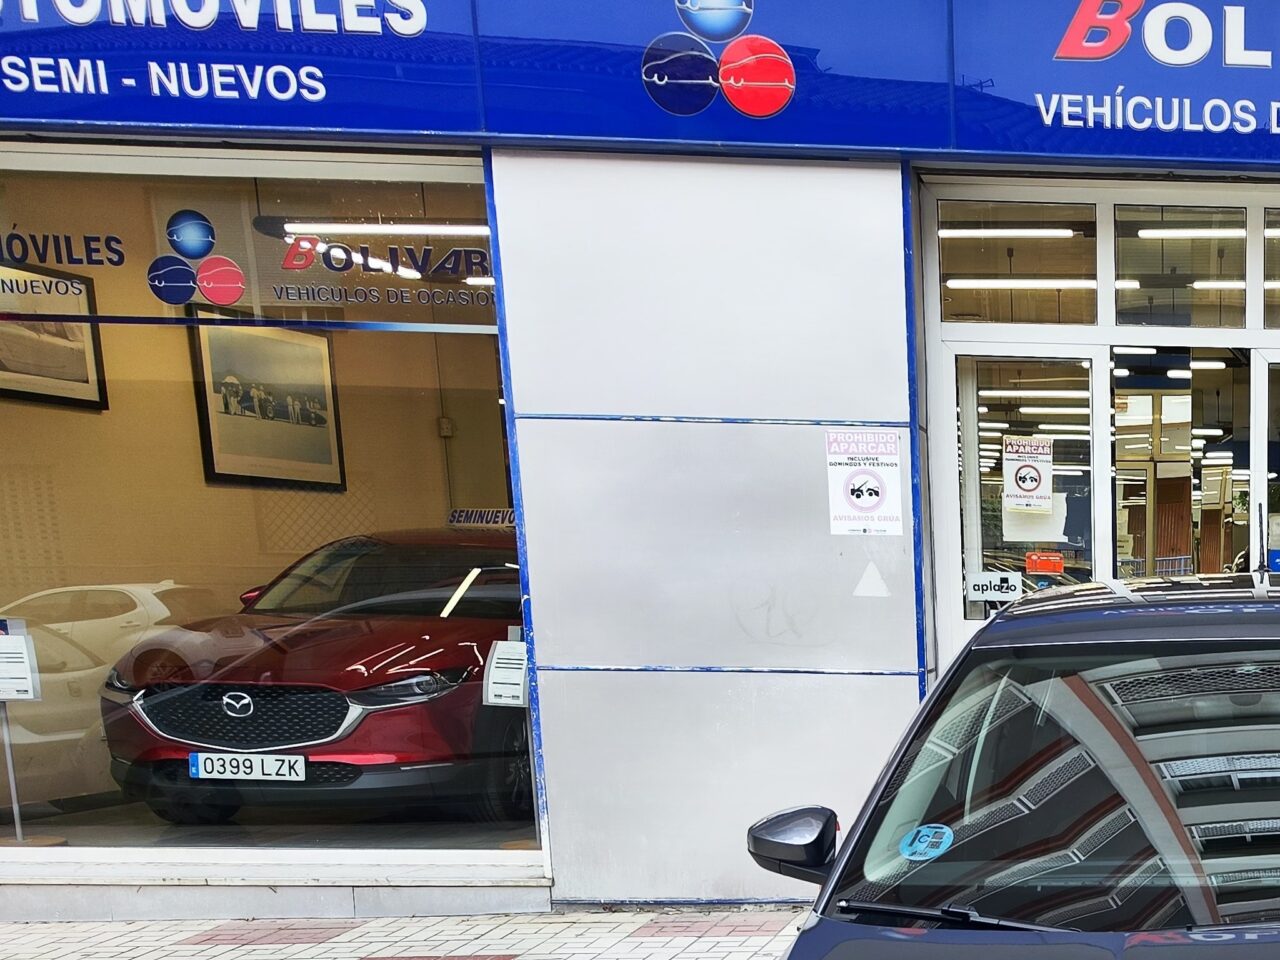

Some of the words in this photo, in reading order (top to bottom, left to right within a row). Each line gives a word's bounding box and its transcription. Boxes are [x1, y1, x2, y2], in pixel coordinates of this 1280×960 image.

[1, 56, 109, 95] SEMI
[148, 61, 328, 102] NUEVOS
[1035, 86, 1257, 135] VEHÍCULOS
[0, 223, 125, 266] ÓVILES
[1, 278, 83, 296] NUEVOS
[386, 288, 412, 305] DE
[829, 432, 897, 443] PROHIBIDO
[830, 442, 897, 454] APARCAR
[1006, 445, 1051, 455] APARCAR
[832, 514, 875, 522] AVISAMOS
[972, 580, 1017, 595] aplazo
[203, 756, 254, 776] 0399
[260, 758, 300, 777] LZK
